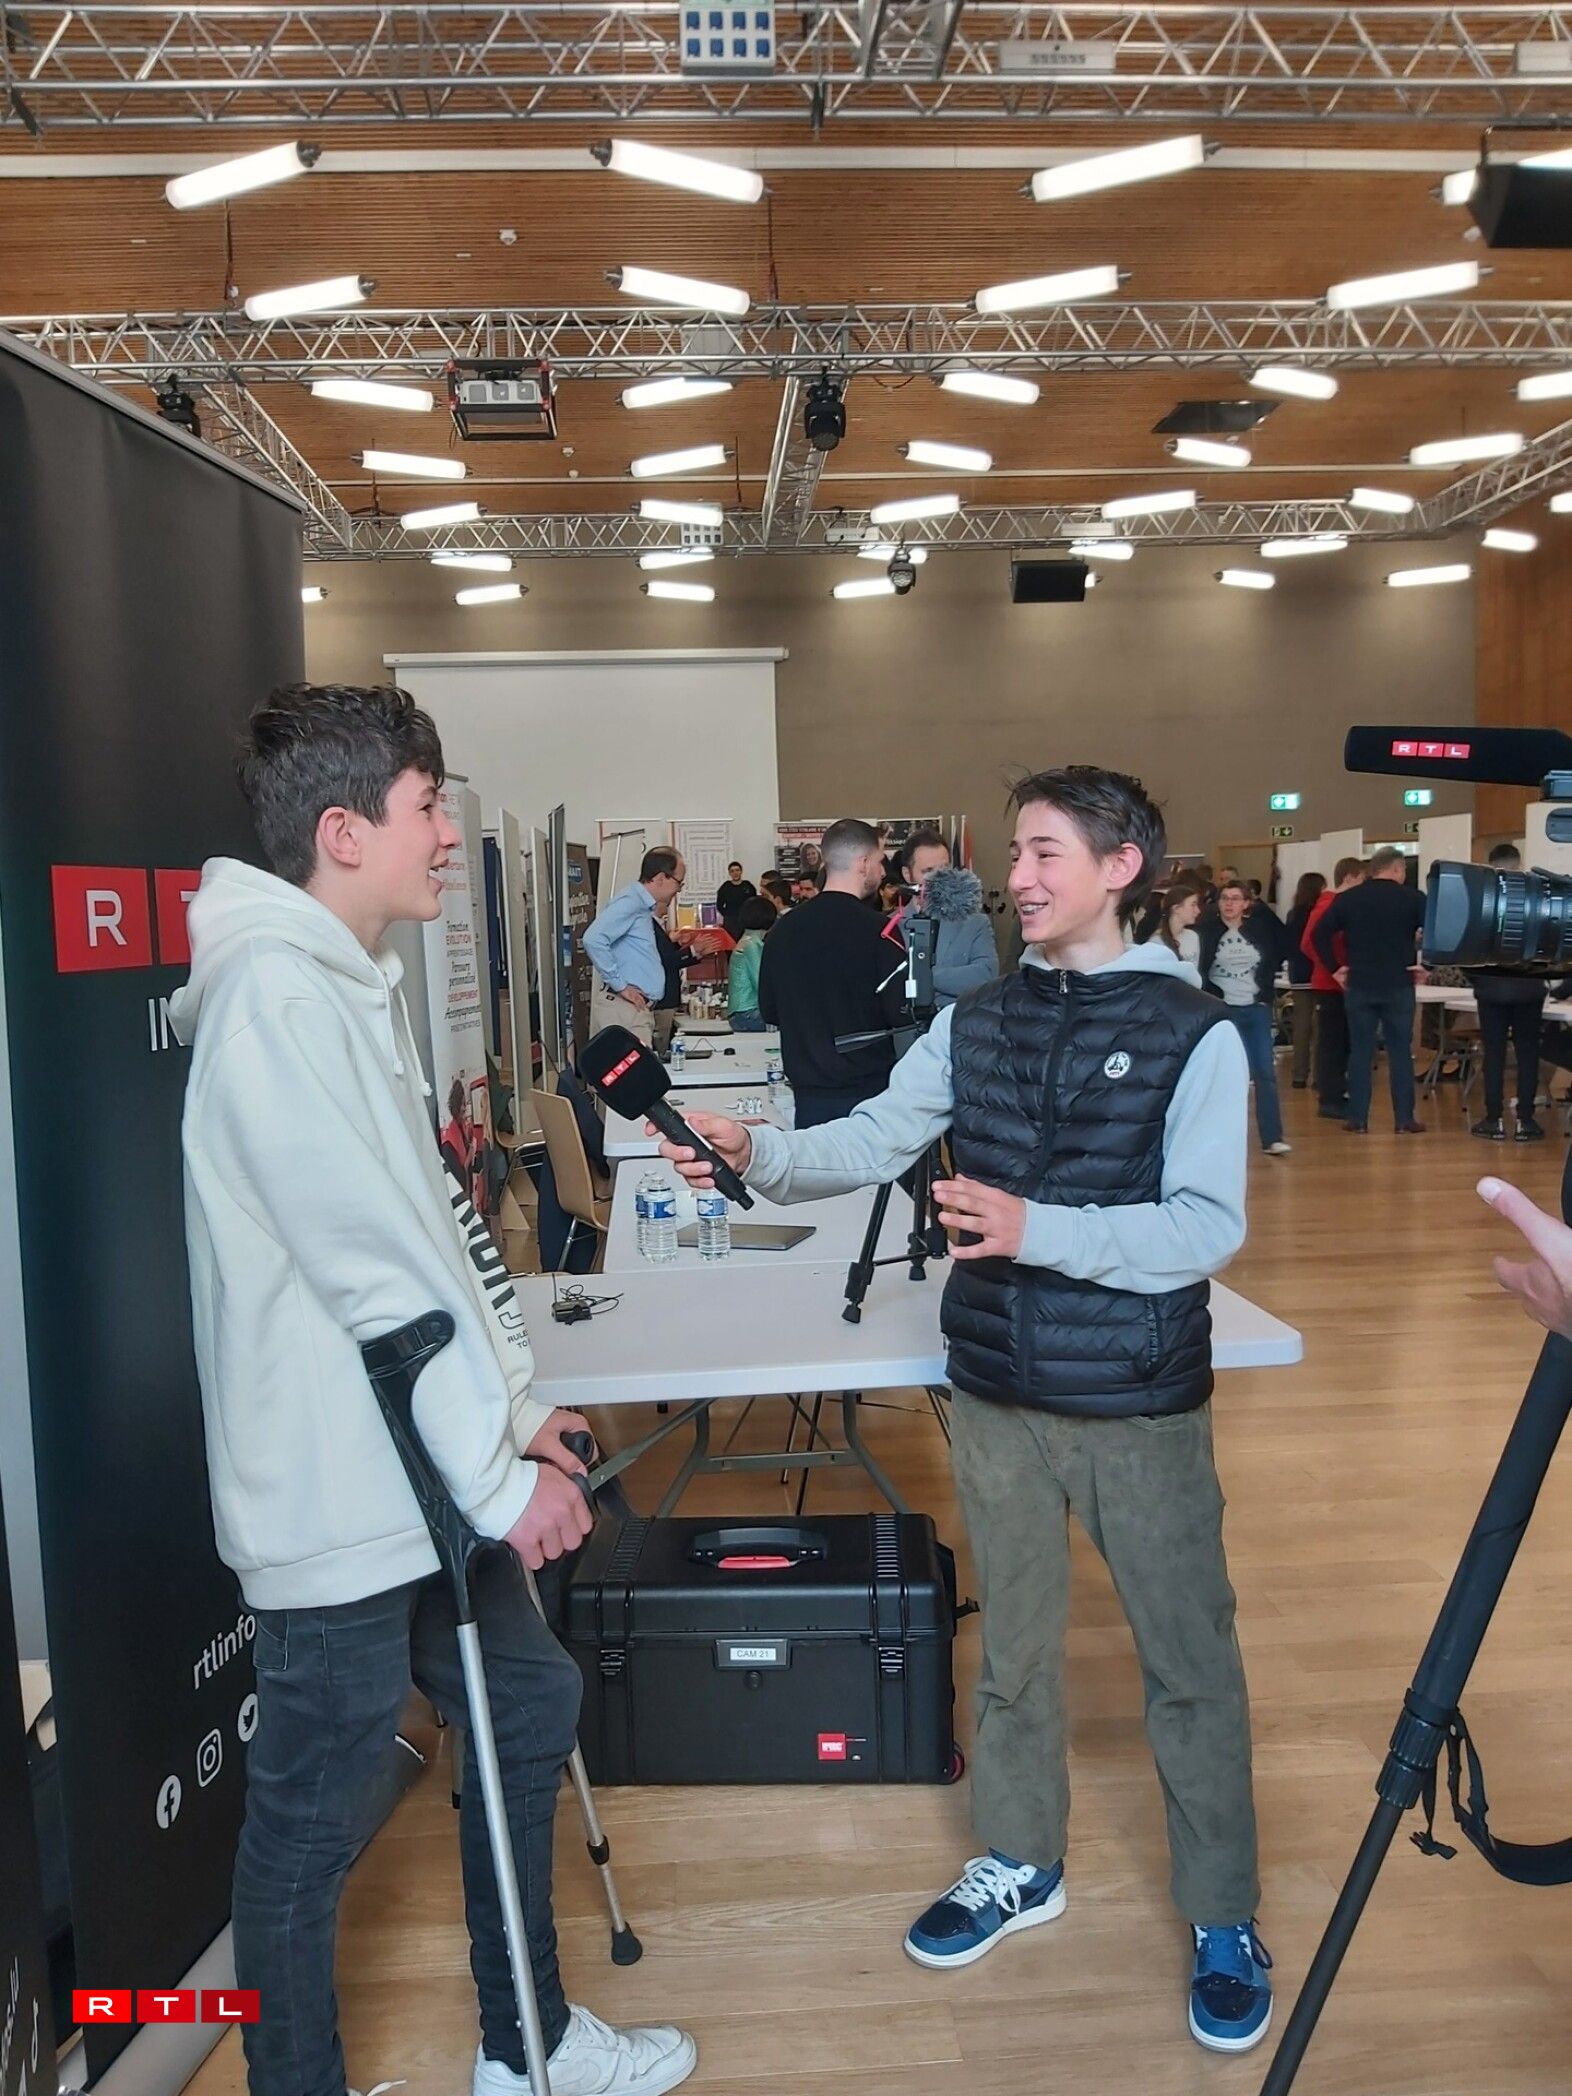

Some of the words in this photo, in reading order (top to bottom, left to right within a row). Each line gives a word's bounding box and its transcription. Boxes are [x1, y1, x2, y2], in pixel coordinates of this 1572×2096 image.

[1398, 744, 1462, 755] RTL
[603, 1051, 639, 1085] RTL
[193, 1614, 256, 1690] rtlinfo
[737, 1649, 757, 1657] CAM
[760, 1649, 769, 1657] 21
